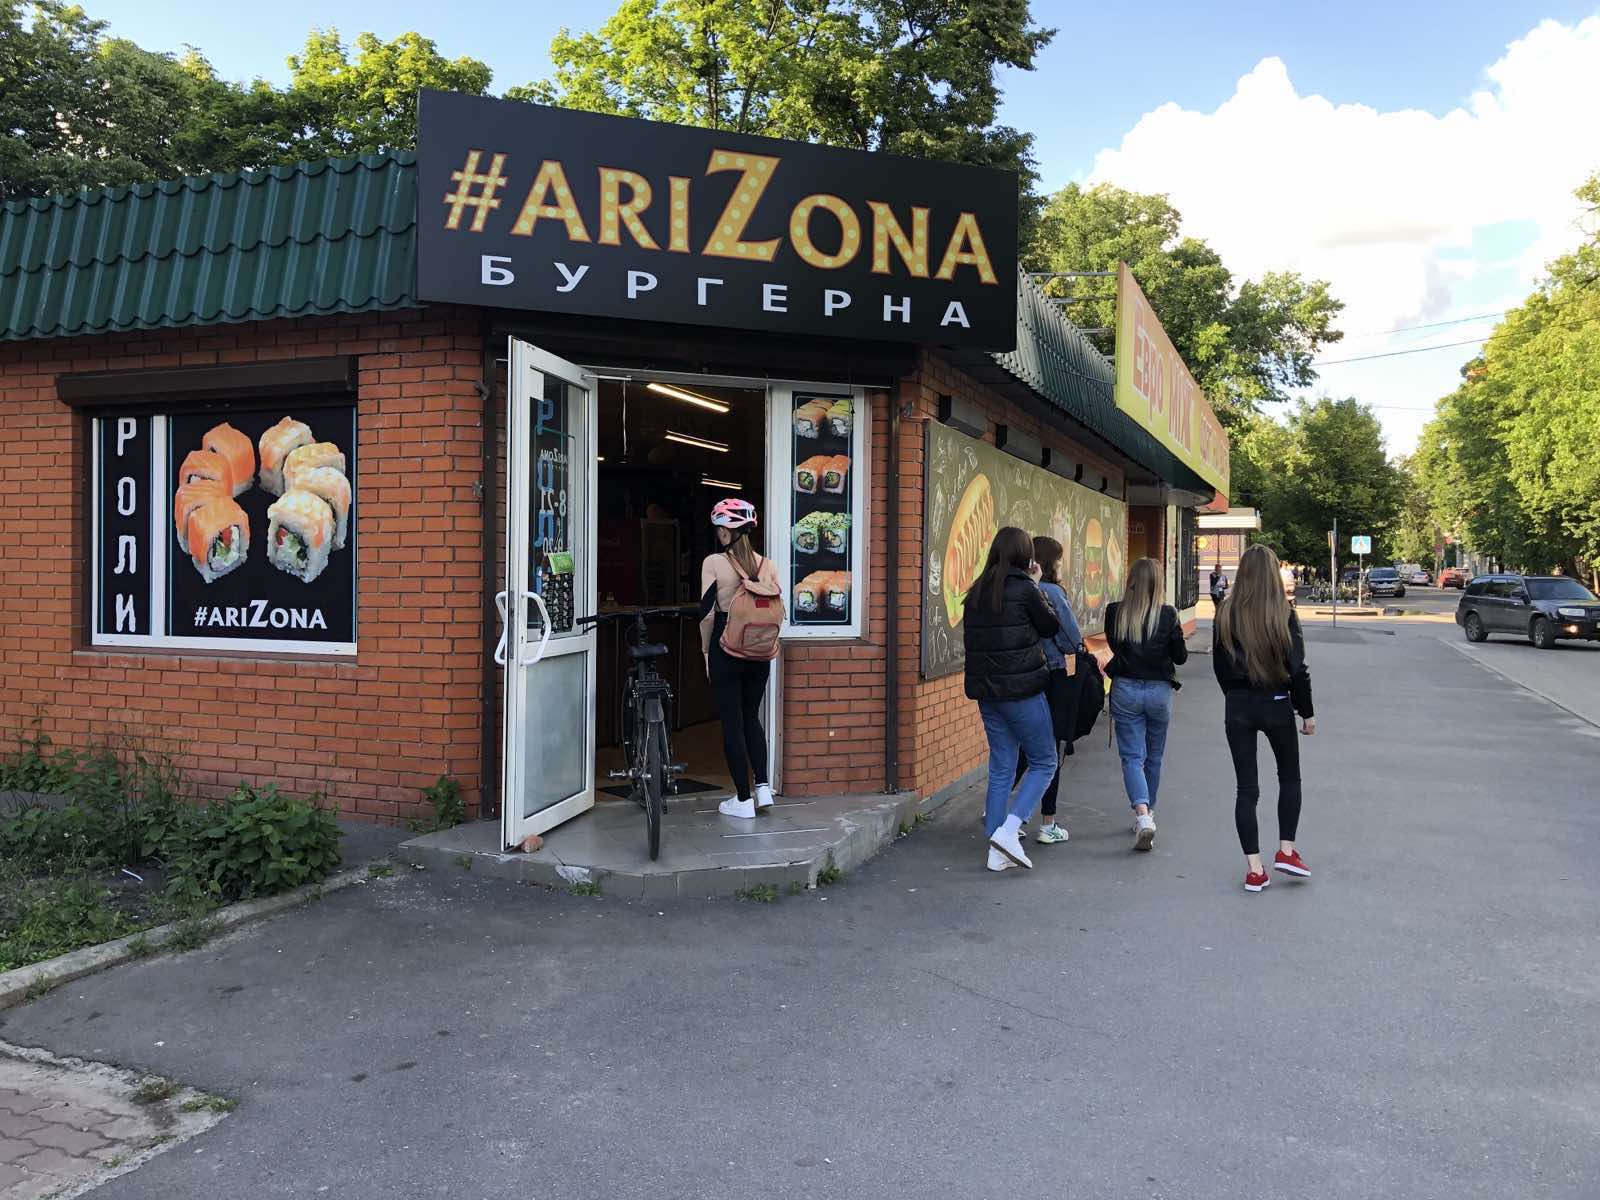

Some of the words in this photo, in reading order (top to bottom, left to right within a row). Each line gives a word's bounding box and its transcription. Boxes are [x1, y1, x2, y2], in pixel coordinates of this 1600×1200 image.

[443, 148, 998, 286] #ARIZONA
[480, 254, 970, 328] БУРГЕРНА
[113, 417, 137, 633] РОЛИ
[193, 599, 328, 630] #ARIZONA
